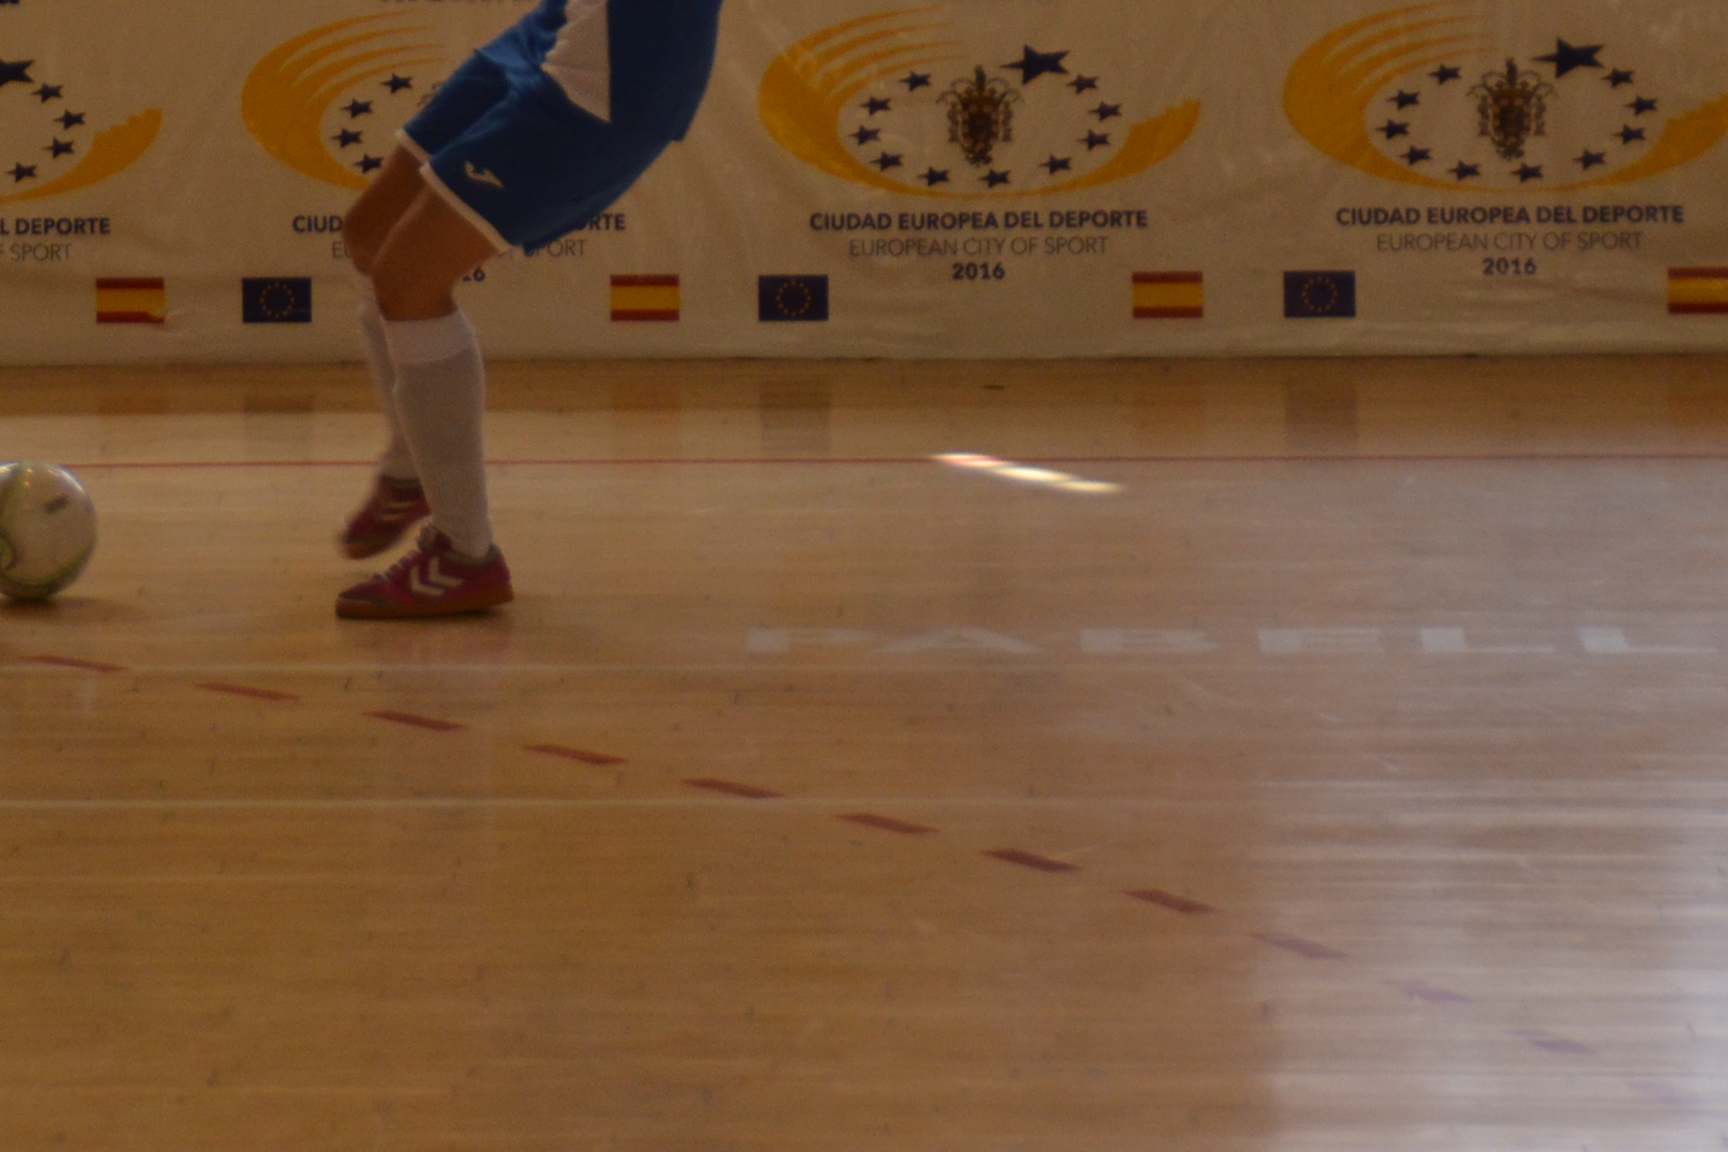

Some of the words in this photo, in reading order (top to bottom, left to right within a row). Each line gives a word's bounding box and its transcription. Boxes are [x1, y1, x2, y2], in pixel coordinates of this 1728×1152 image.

[293, 215, 343, 233] CIUD
[810, 213, 892, 231] CIUDAD
[898, 211, 999, 230] EUROPEA
[1004, 211, 1043, 229] DEL
[1049, 209, 1147, 228] DEPORTE
[1336, 206, 1421, 225] CIUDAD
[1427, 206, 1532, 225] EUROPEA
[1537, 205, 1578, 224] DEL
[1583, 204, 1685, 223] DEPORTE
[15, 216, 111, 235] DEPORTE
[850, 238, 958, 257] EUROPEAN
[963, 237, 1006, 255] CITY
[1011, 236, 1039, 255] OF
[1045, 236, 1108, 254] SPORT
[1377, 233, 1488, 252] EUROPEAN
[1494, 232, 1537, 251] CITY
[1543, 231, 1571, 250] OF
[1577, 231, 1643, 249] SPORT
[11, 242, 72, 261] SPORT
[952, 263, 1005, 280] 2016
[1482, 257, 1537, 275] 2016
